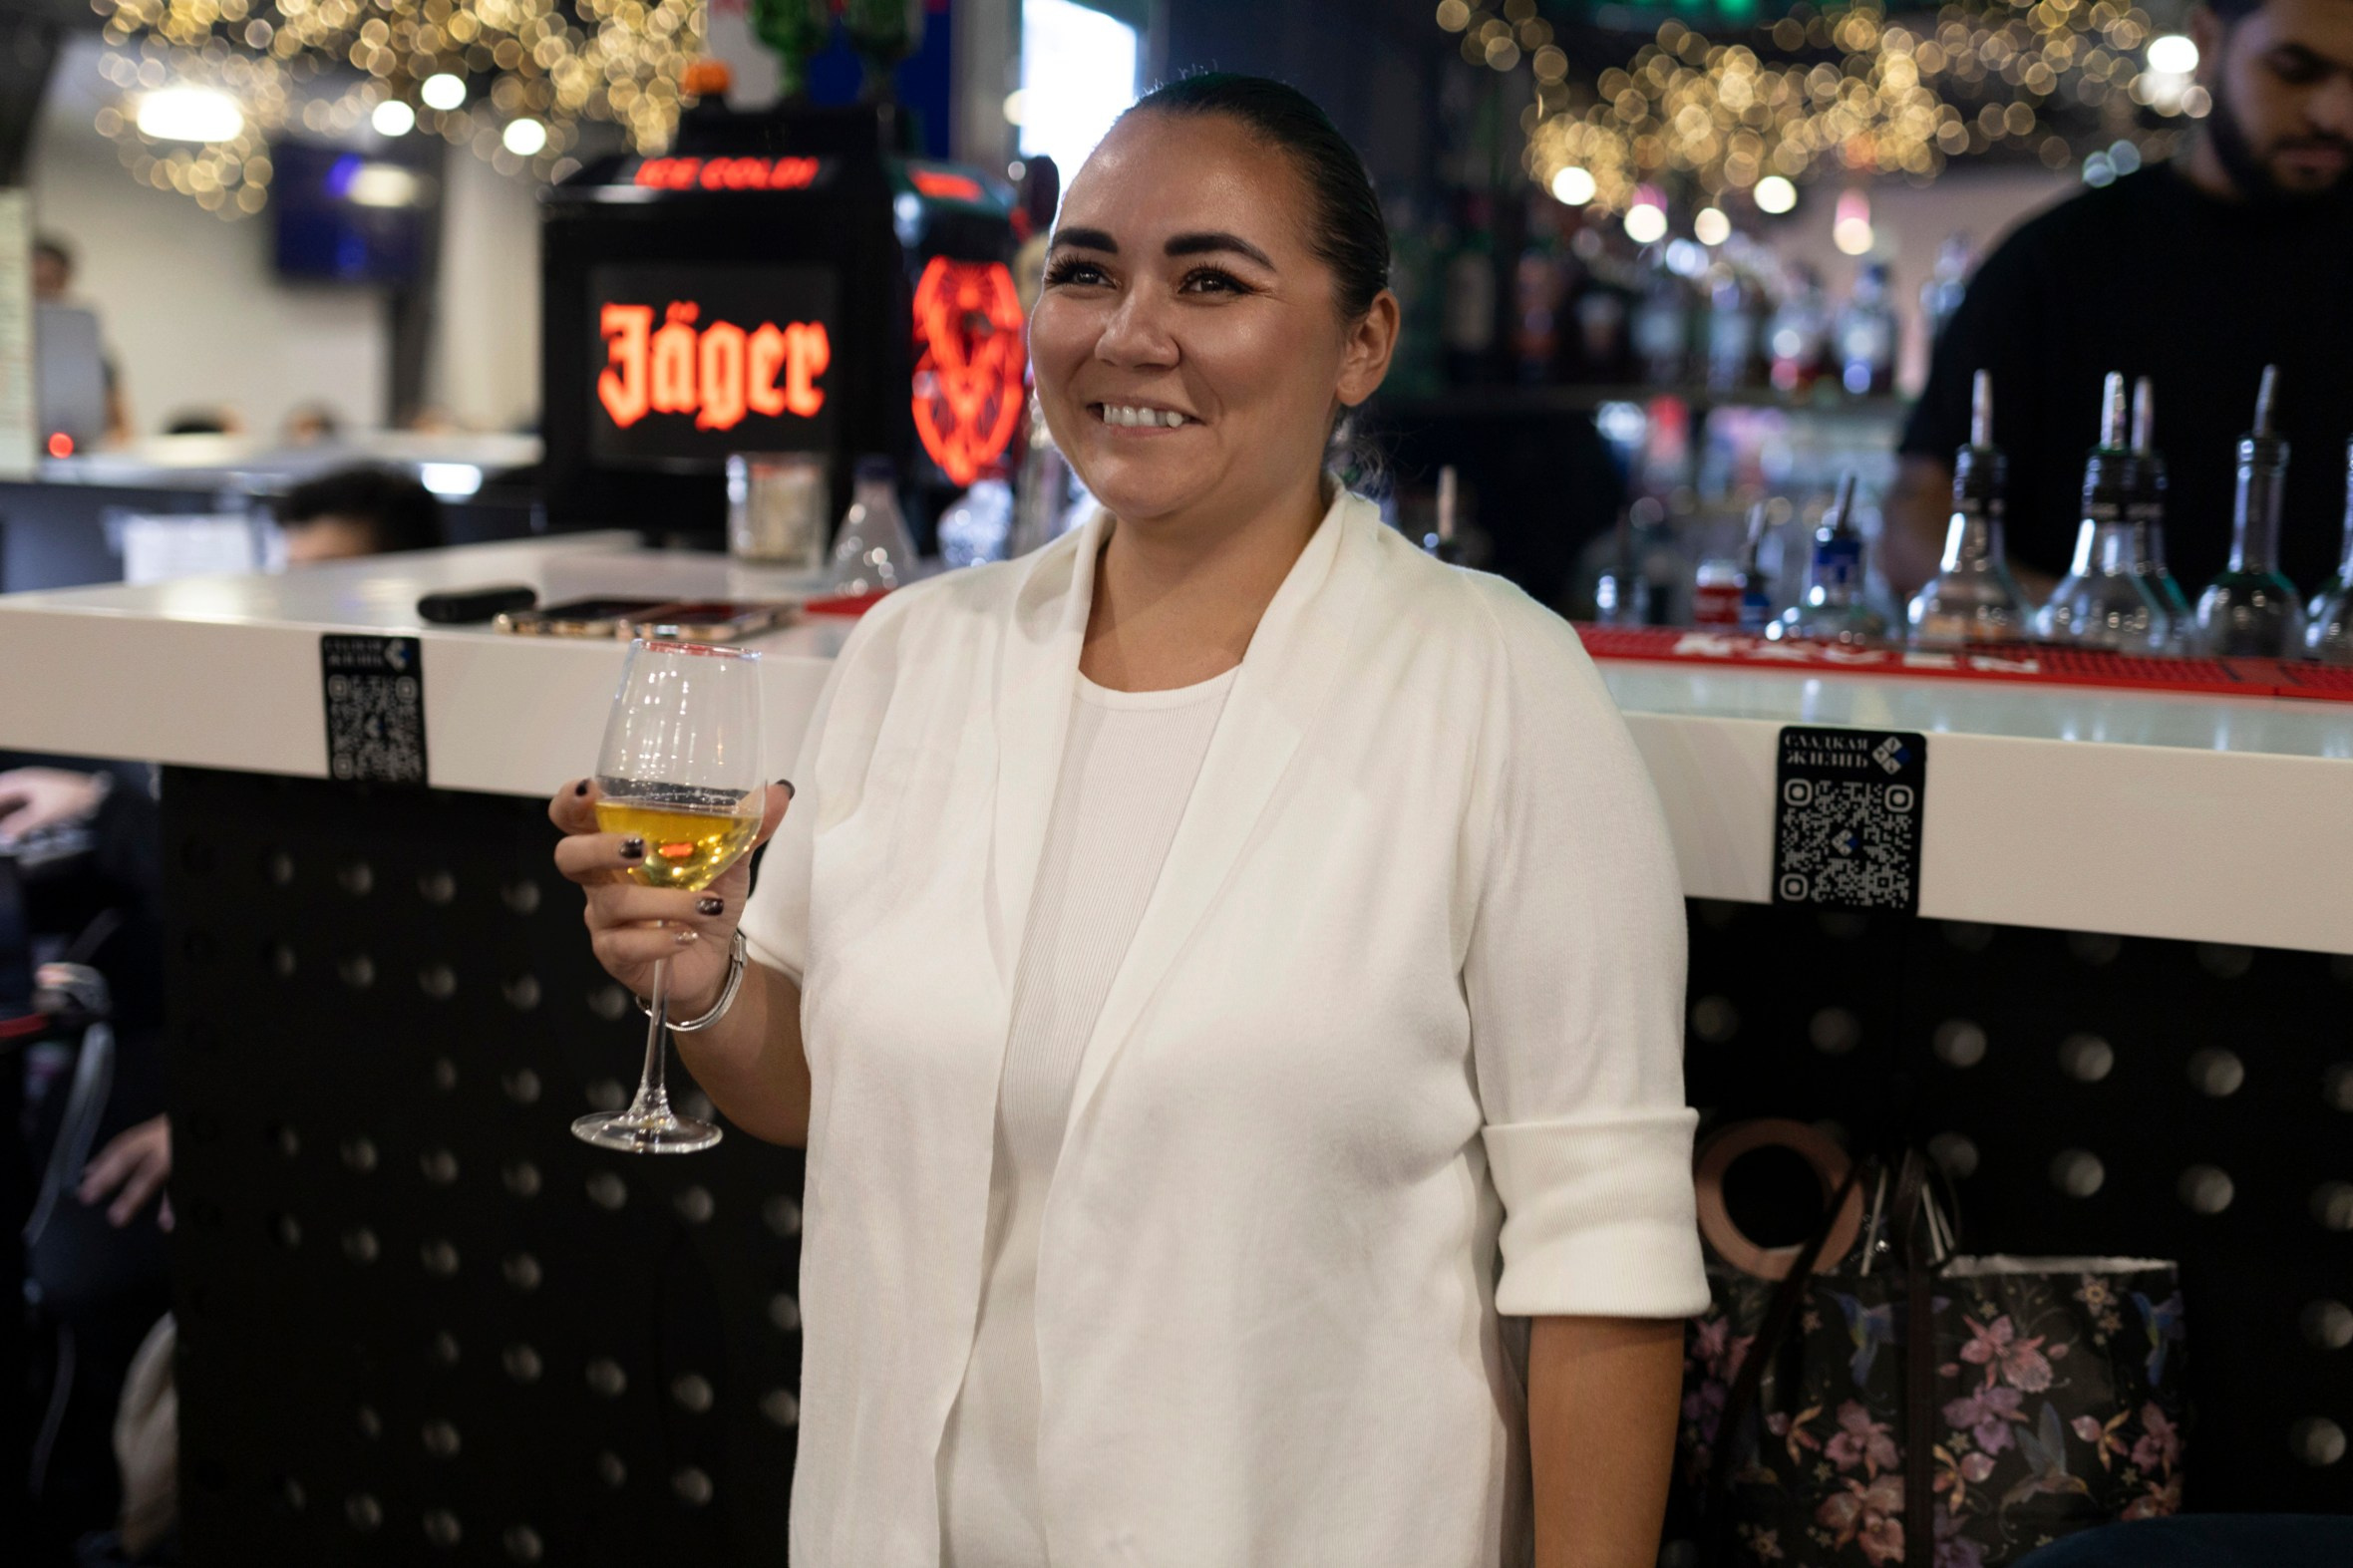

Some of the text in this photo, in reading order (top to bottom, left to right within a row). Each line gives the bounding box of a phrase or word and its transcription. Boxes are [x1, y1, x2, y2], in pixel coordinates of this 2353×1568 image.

[635, 157, 700, 190] ICE
[597, 301, 831, 431] Jäger
[1785, 735, 1869, 752] СЛАДКАЯ
[1786, 751, 1869, 768] ЖИЗНЬ
